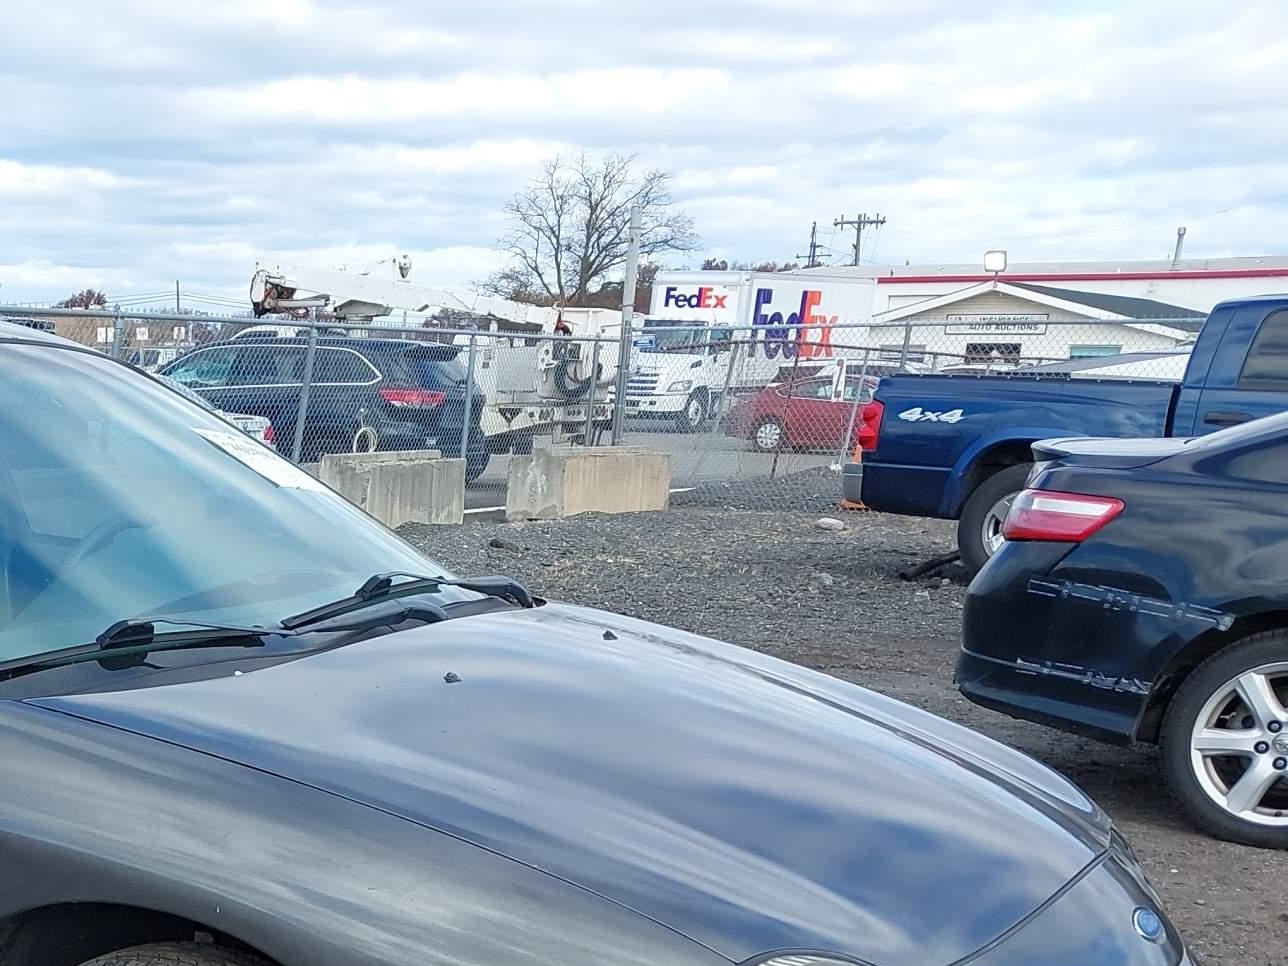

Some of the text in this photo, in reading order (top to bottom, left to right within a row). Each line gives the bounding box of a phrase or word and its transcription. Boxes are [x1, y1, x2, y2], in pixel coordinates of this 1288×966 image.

[663, 286, 729, 309] FedEx
[747, 287, 839, 360] FedEx
[968, 323, 1039, 331] AUTO AUCTIONS
[897, 407, 967, 424] 4x4
